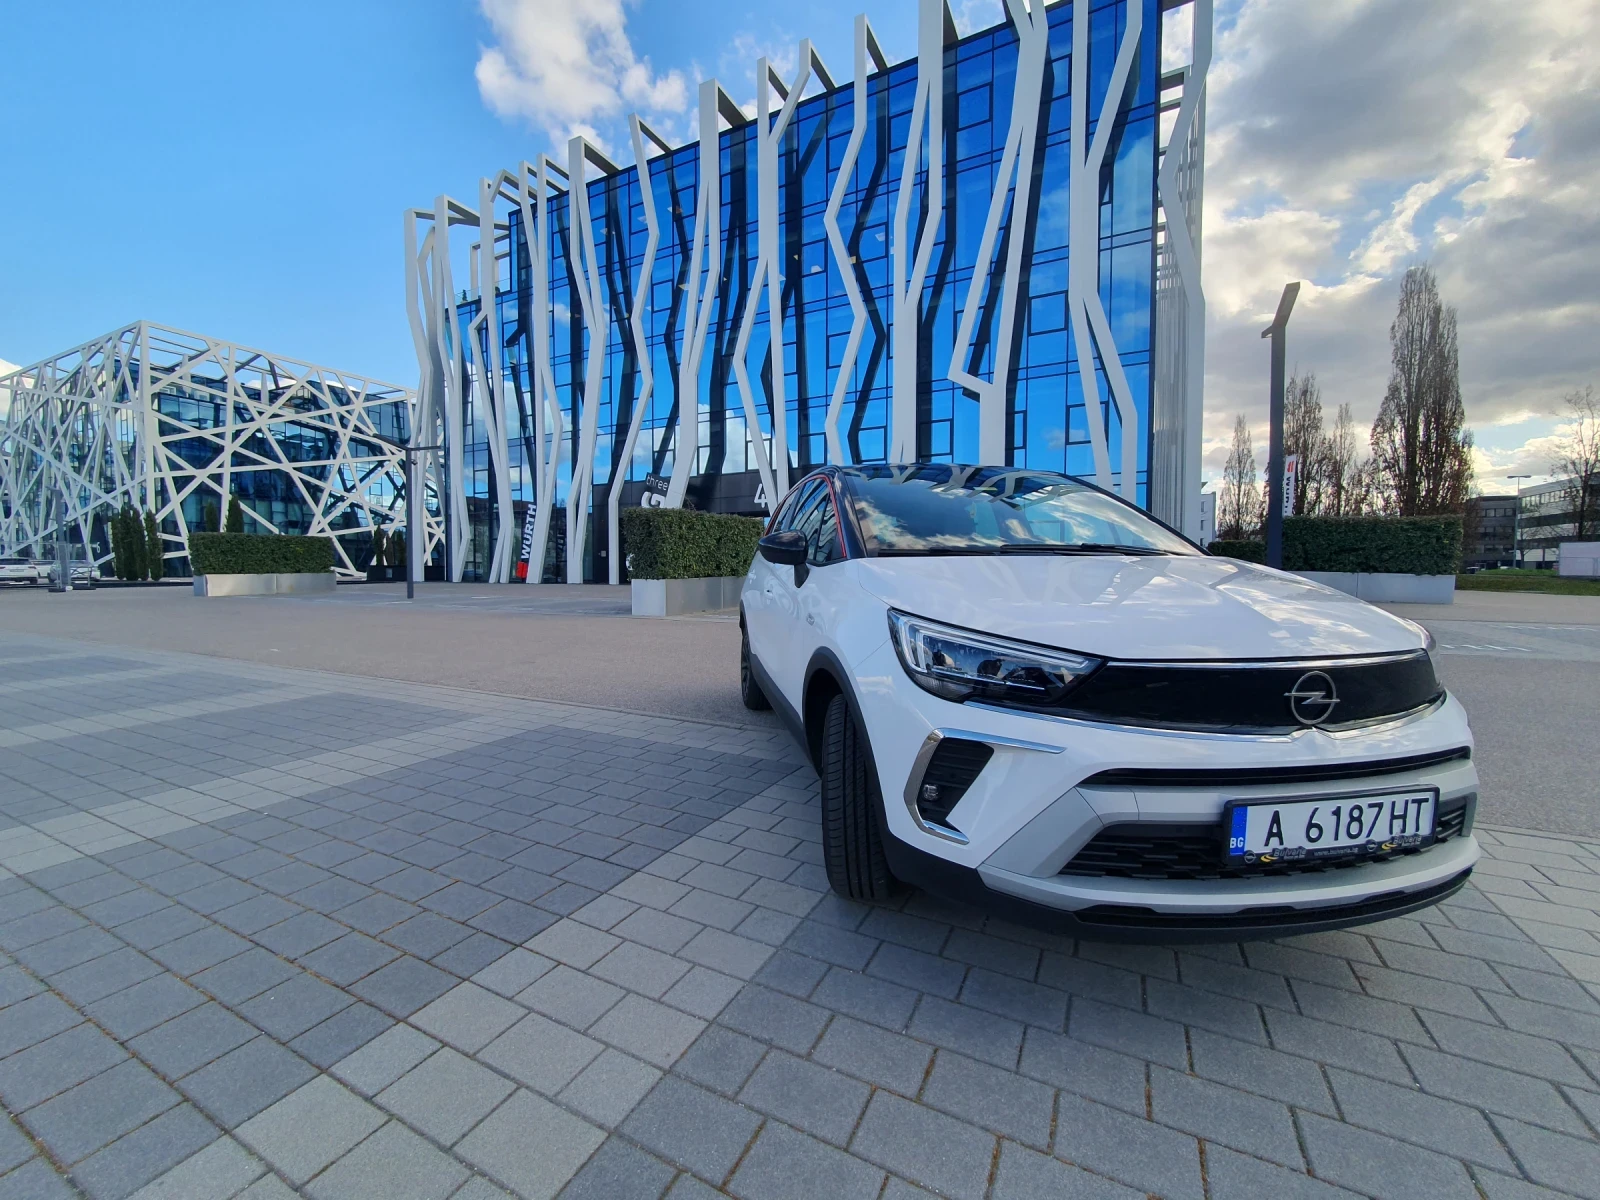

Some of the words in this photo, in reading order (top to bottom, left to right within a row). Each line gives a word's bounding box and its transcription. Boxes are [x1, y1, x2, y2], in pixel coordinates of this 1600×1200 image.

[646, 474, 668, 491] three
[753, 483, 768, 508] 4
[1263, 809, 1284, 847] A
[1229, 837, 1244, 849] BG
